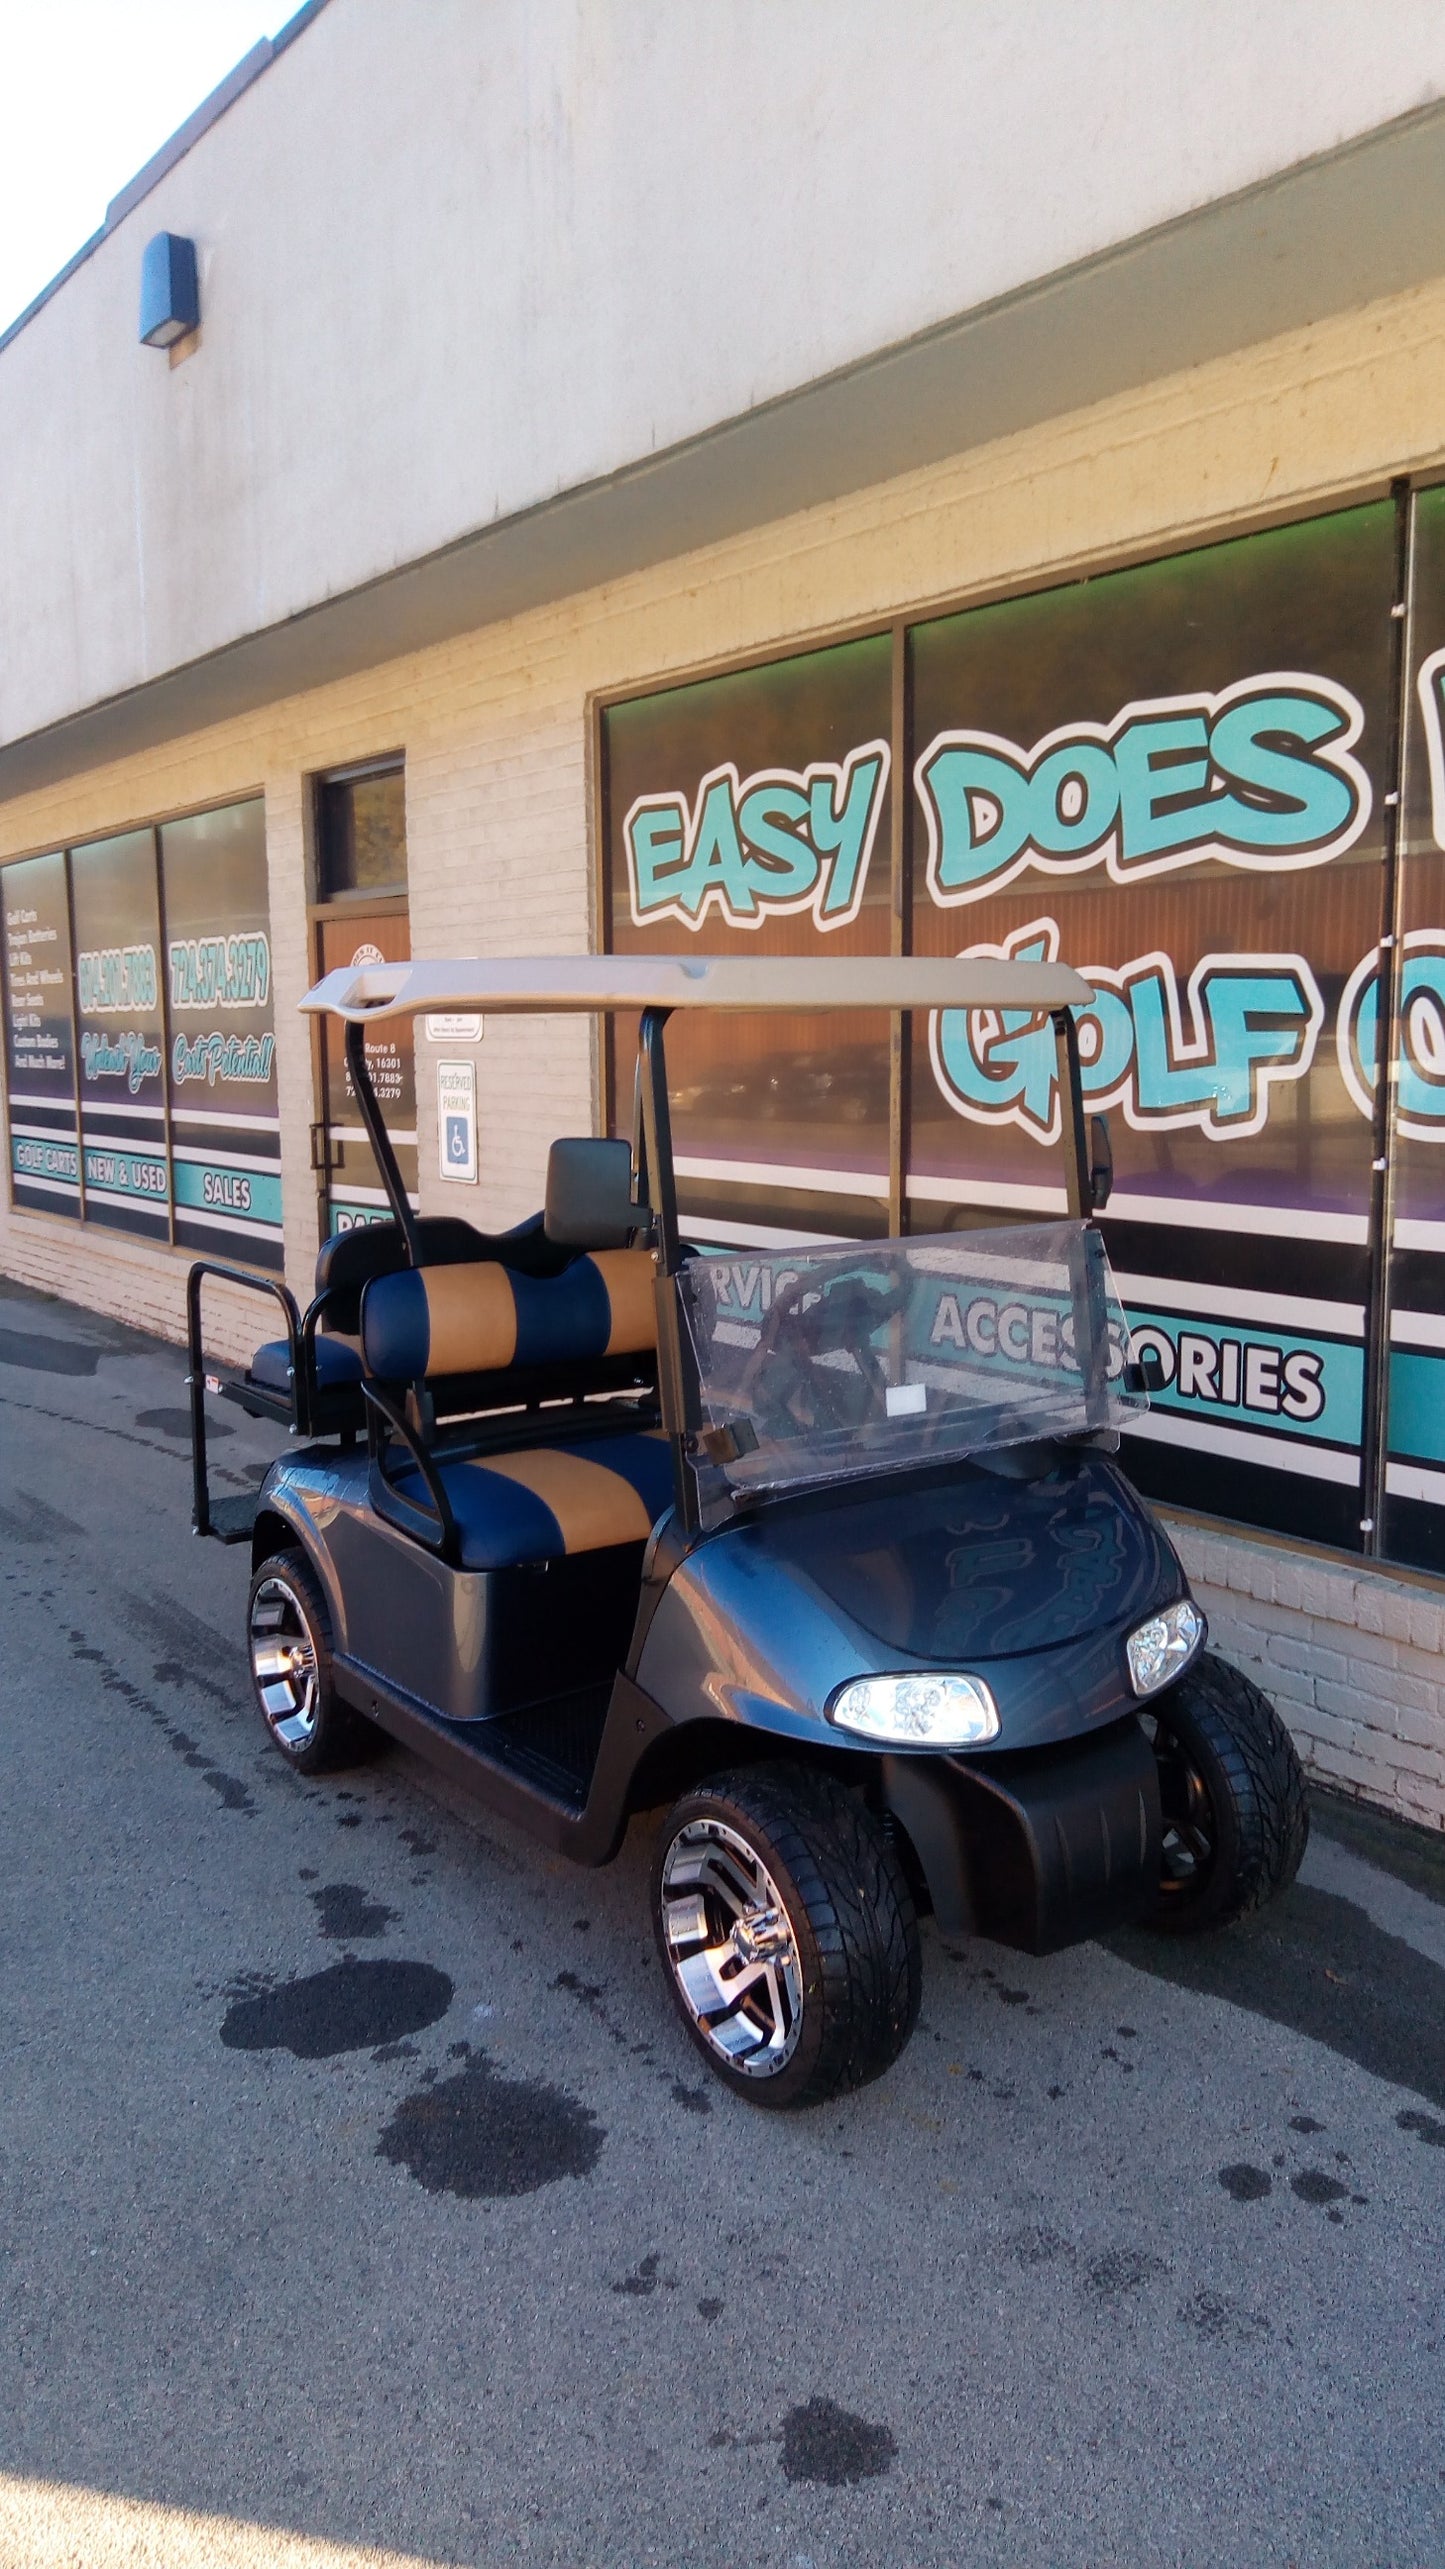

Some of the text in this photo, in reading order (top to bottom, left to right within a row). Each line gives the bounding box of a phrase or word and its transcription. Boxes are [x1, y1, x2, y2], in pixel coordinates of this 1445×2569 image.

[623, 739, 890, 932] EASY
[914, 671, 1372, 908] DOES
[365, 1043, 388, 1054] Route
[928, 916, 1325, 1146] GOLF
[440, 1074, 471, 1090] RESERVED
[442, 1095, 470, 1111] PARKING
[17, 1144, 77, 1176] GOLF CARTS
[87, 1155, 167, 1192] NEW & USED
[203, 1173, 251, 1210] SALES
[930, 1292, 1326, 1423] ACCESSORIES
